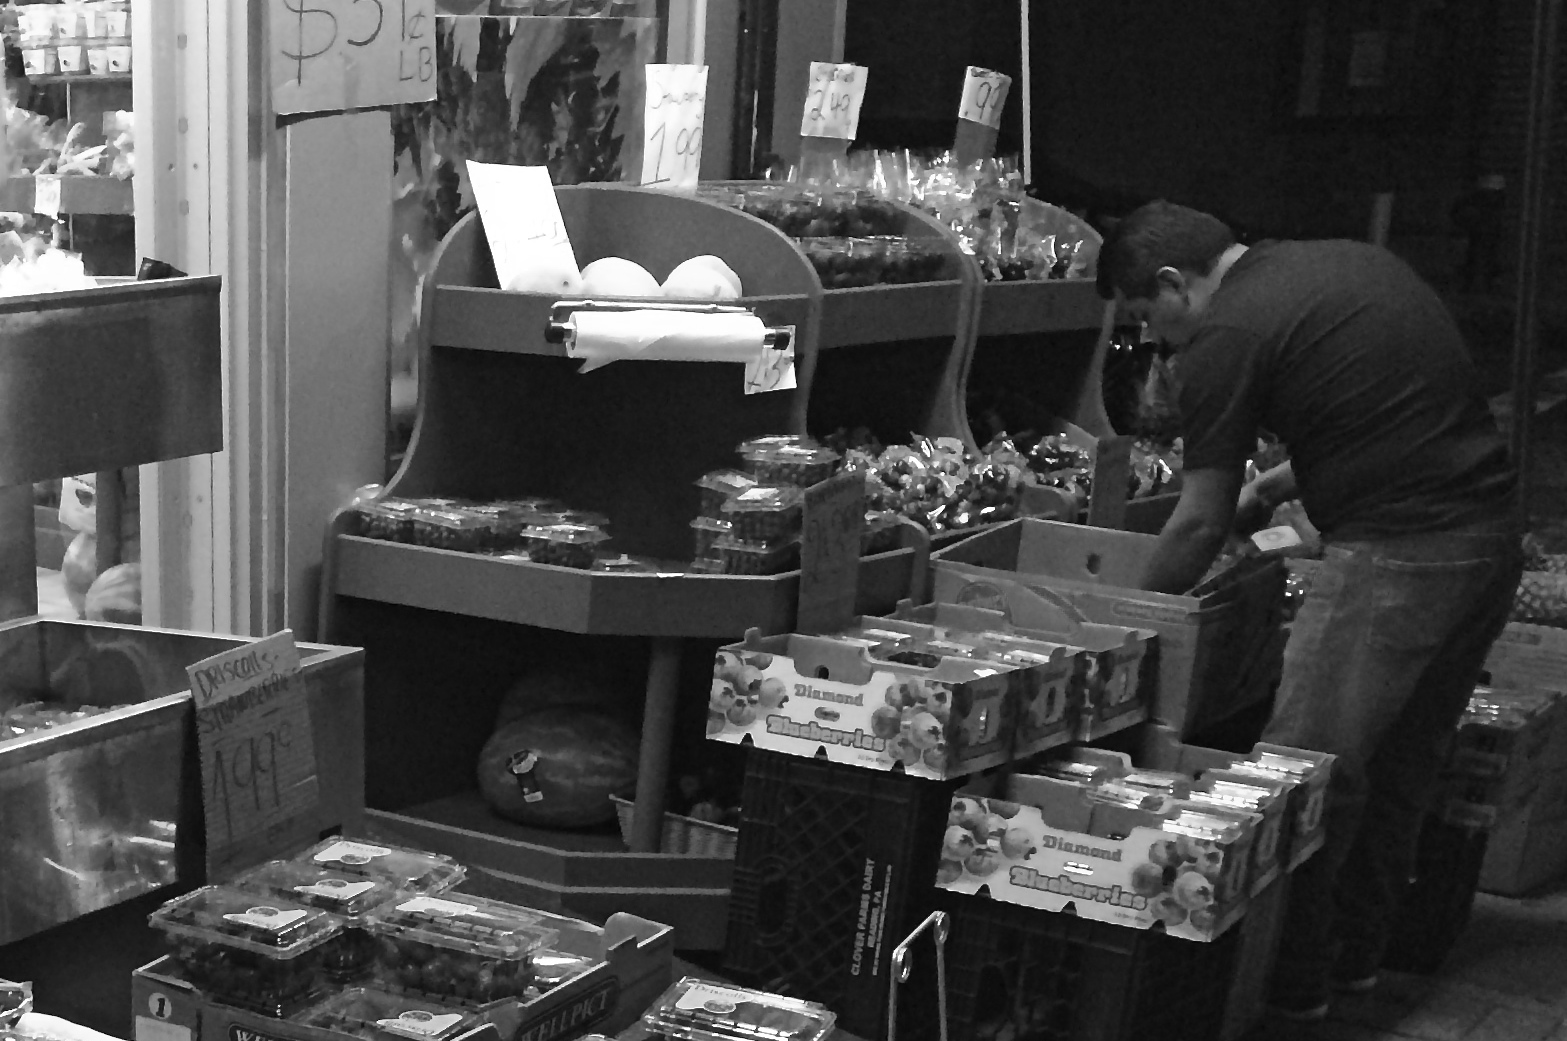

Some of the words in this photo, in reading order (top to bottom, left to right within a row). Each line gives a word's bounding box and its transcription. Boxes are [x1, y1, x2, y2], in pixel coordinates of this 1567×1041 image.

[793, 682, 864, 710] Diamond
[766, 715, 888, 752] Blueberries
[1042, 834, 1124, 864] Diamond
[1008, 865, 1149, 912] Blueberries
[850, 931, 866, 977] CLOVER
[155, 996, 167, 1018] 1
